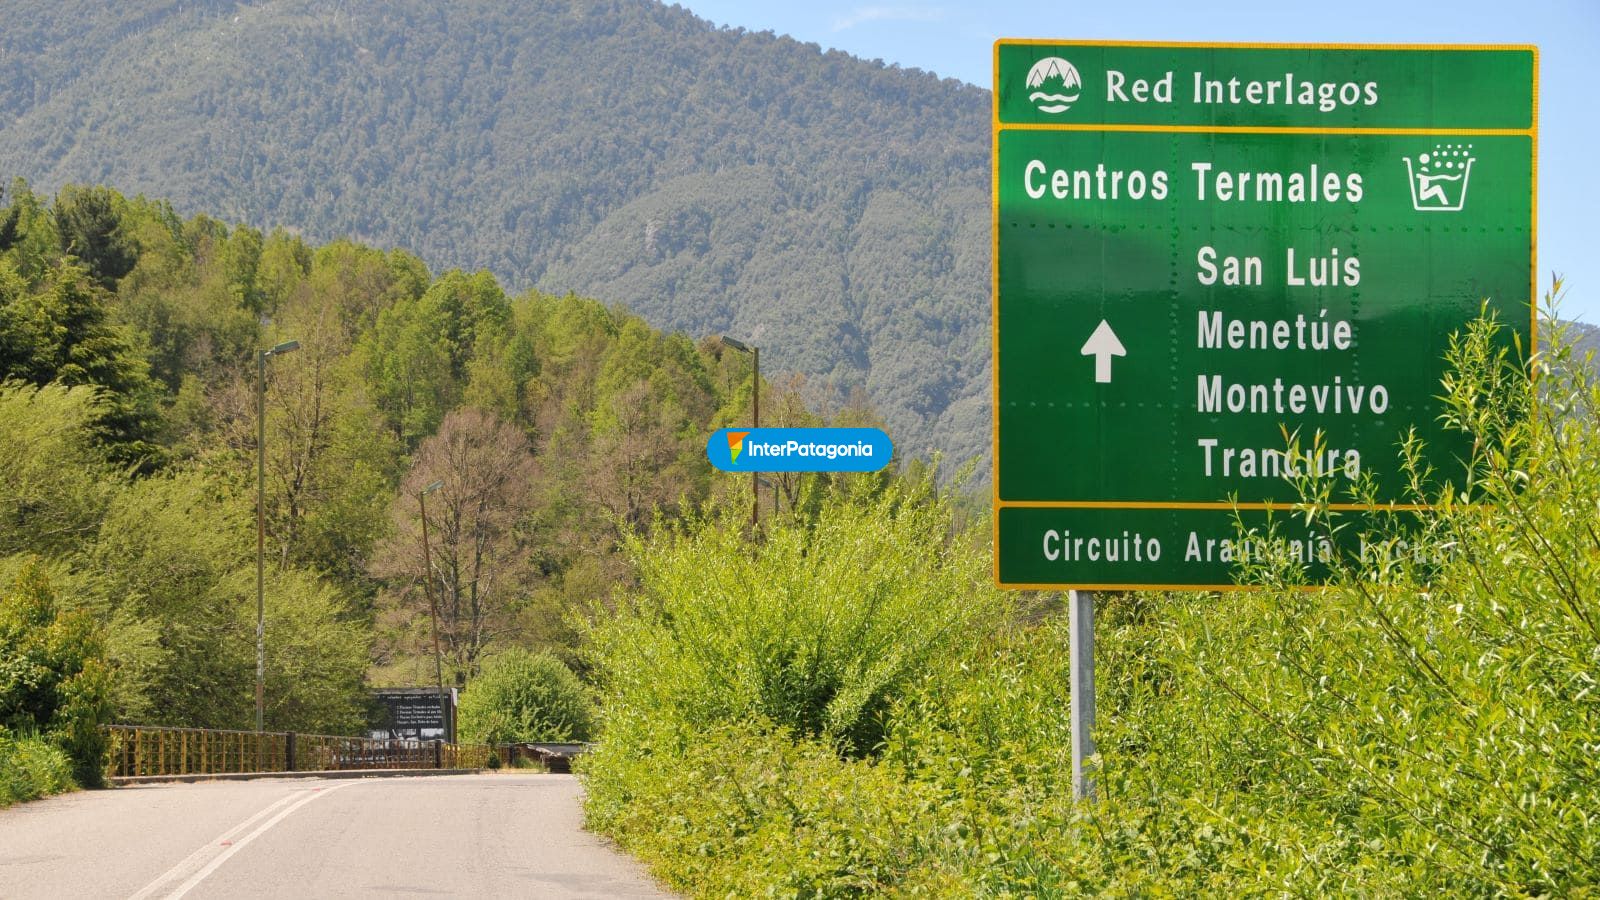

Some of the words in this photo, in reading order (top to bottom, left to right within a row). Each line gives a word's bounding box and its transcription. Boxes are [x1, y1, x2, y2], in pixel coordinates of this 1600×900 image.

[1106, 70, 1173, 103] Red
[1193, 71, 1378, 112] Interlagos
[1024, 159, 1169, 201] Centros
[1191, 162, 1364, 203] Termales
[1197, 245, 1262, 286] San
[1287, 247, 1361, 287] Luis
[1197, 308, 1352, 351] Menetúe
[1197, 374, 1389, 414] Montevivo
[1043, 529, 1161, 562] Circuito
